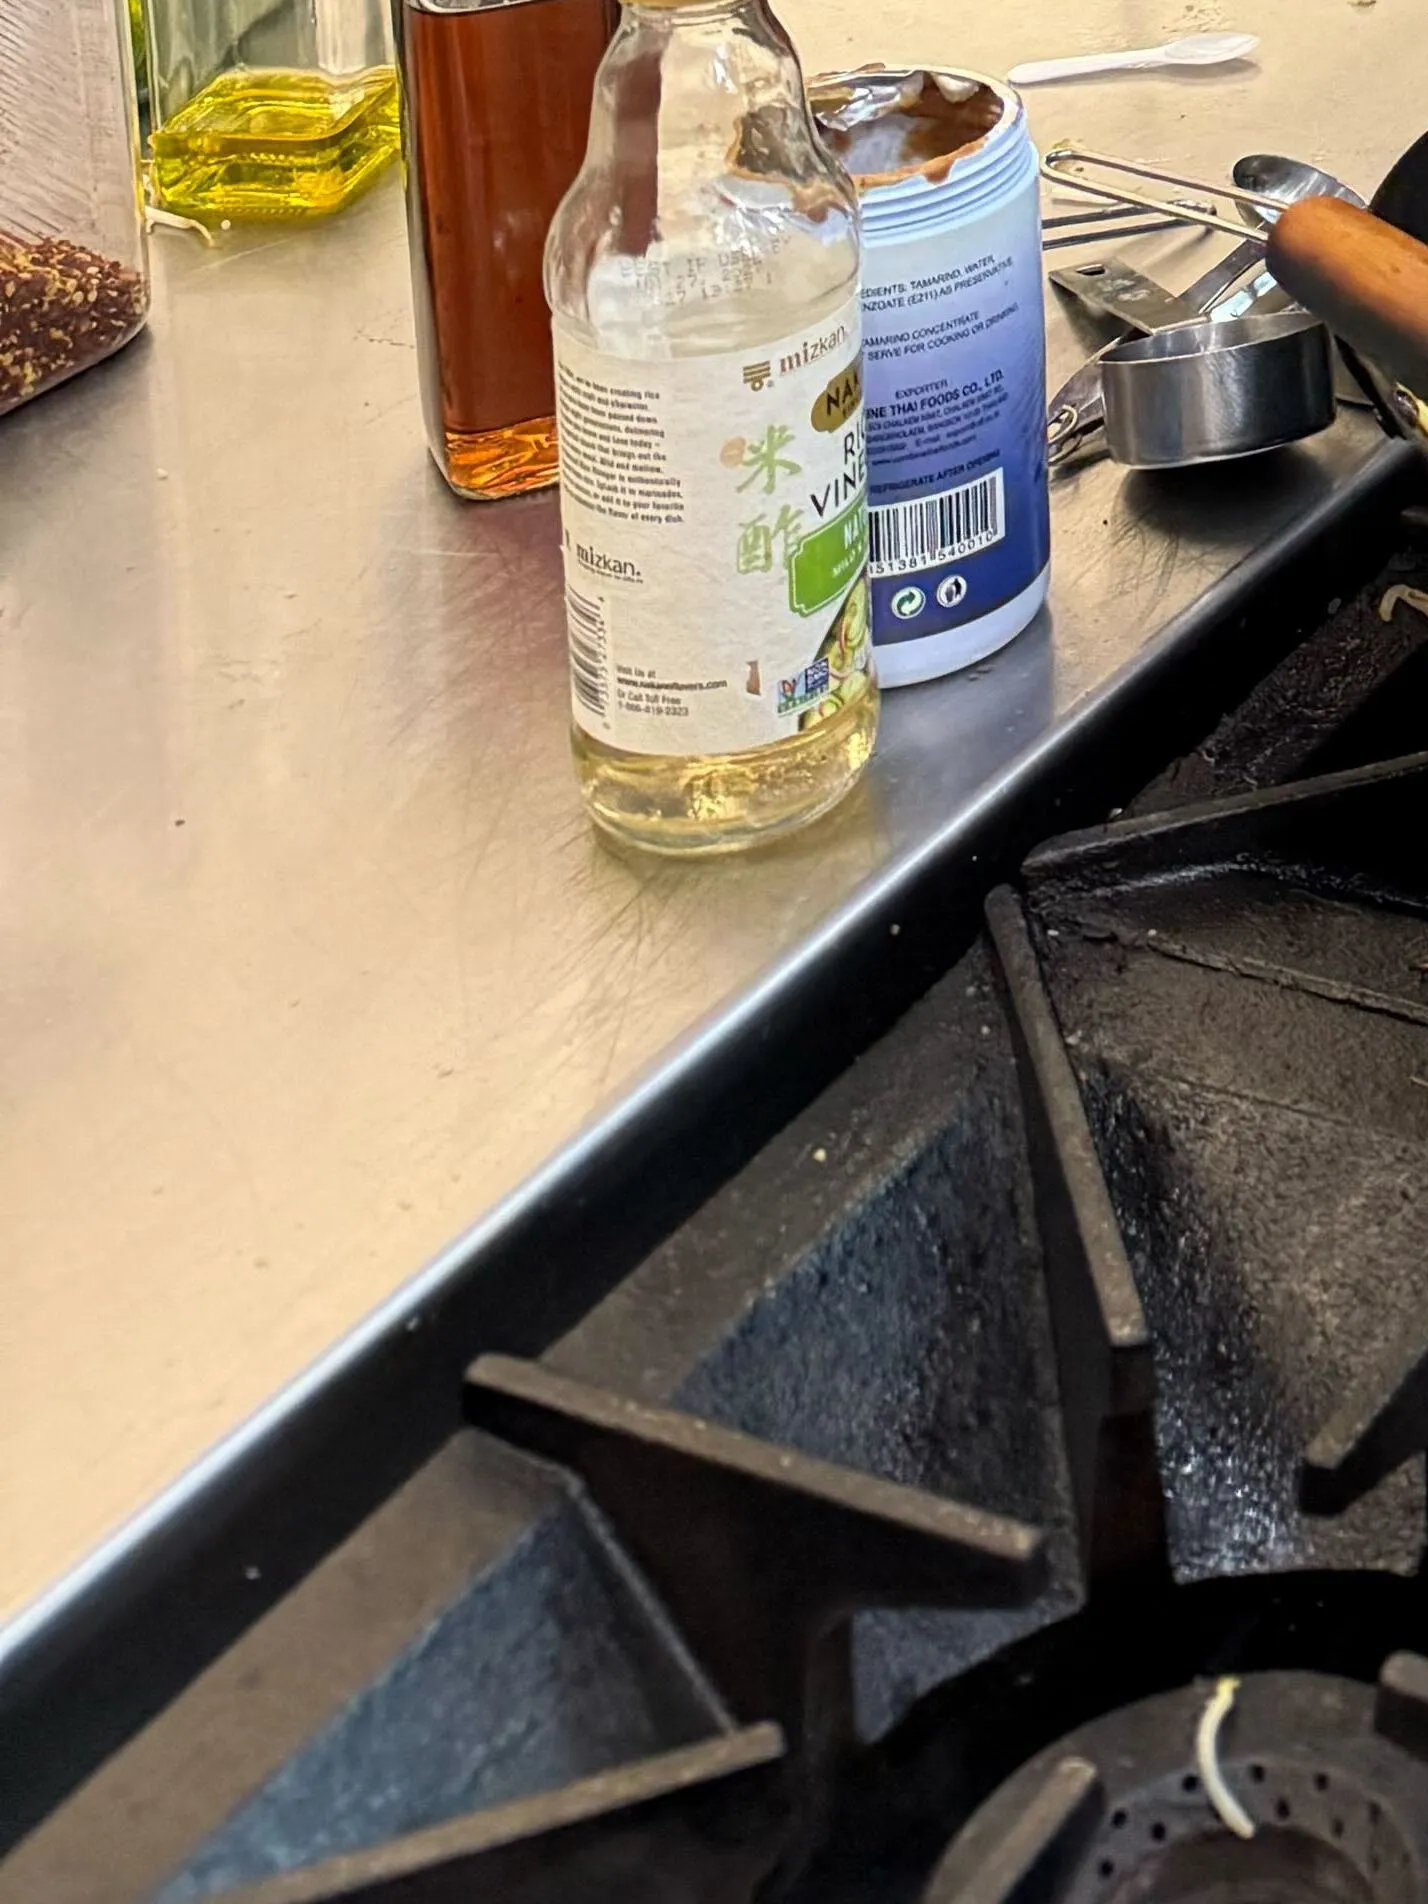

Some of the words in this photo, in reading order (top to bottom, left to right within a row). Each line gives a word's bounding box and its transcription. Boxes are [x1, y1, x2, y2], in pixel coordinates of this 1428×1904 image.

[911, 310, 980, 340] CONCENTRATE
[780, 325, 846, 374] mizkan
[903, 342, 926, 356] FOR
[927, 328, 971, 351] COOKING
[895, 377, 949, 400] EXPORTER
[889, 401, 919, 417] THAI
[920, 389, 961, 411] FOODS
[936, 464, 966, 482] AFTER
